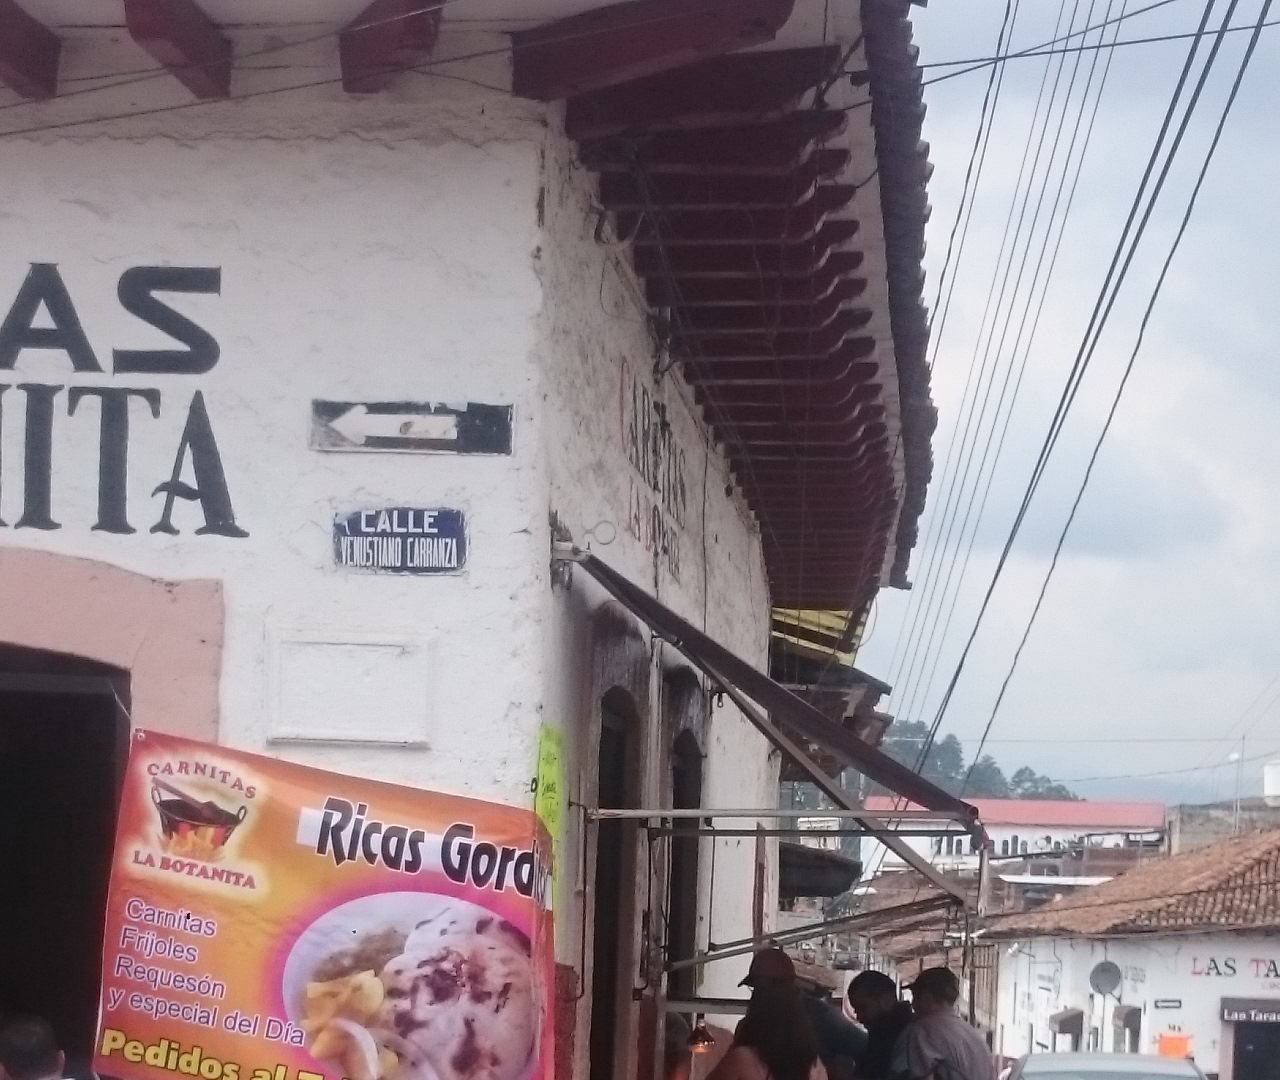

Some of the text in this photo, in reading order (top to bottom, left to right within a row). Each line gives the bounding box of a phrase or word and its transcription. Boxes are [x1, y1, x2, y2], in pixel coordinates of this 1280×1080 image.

[361, 509, 439, 533] CALLE
[340, 536, 458, 568] VENUSTIANO CARRANZA
[147, 761, 256, 799] CARNITAS
[316, 796, 425, 876] Ricas
[132, 850, 256, 889] LA BOTANITA
[126, 898, 217, 937] Carnitas
[120, 927, 198, 963] Frijoles
[115, 955, 225, 999] Requesón
[1191, 956, 1237, 977] LAS
[108, 987, 305, 1047] y especial del Día
[1224, 1008, 1247, 1022] Las
